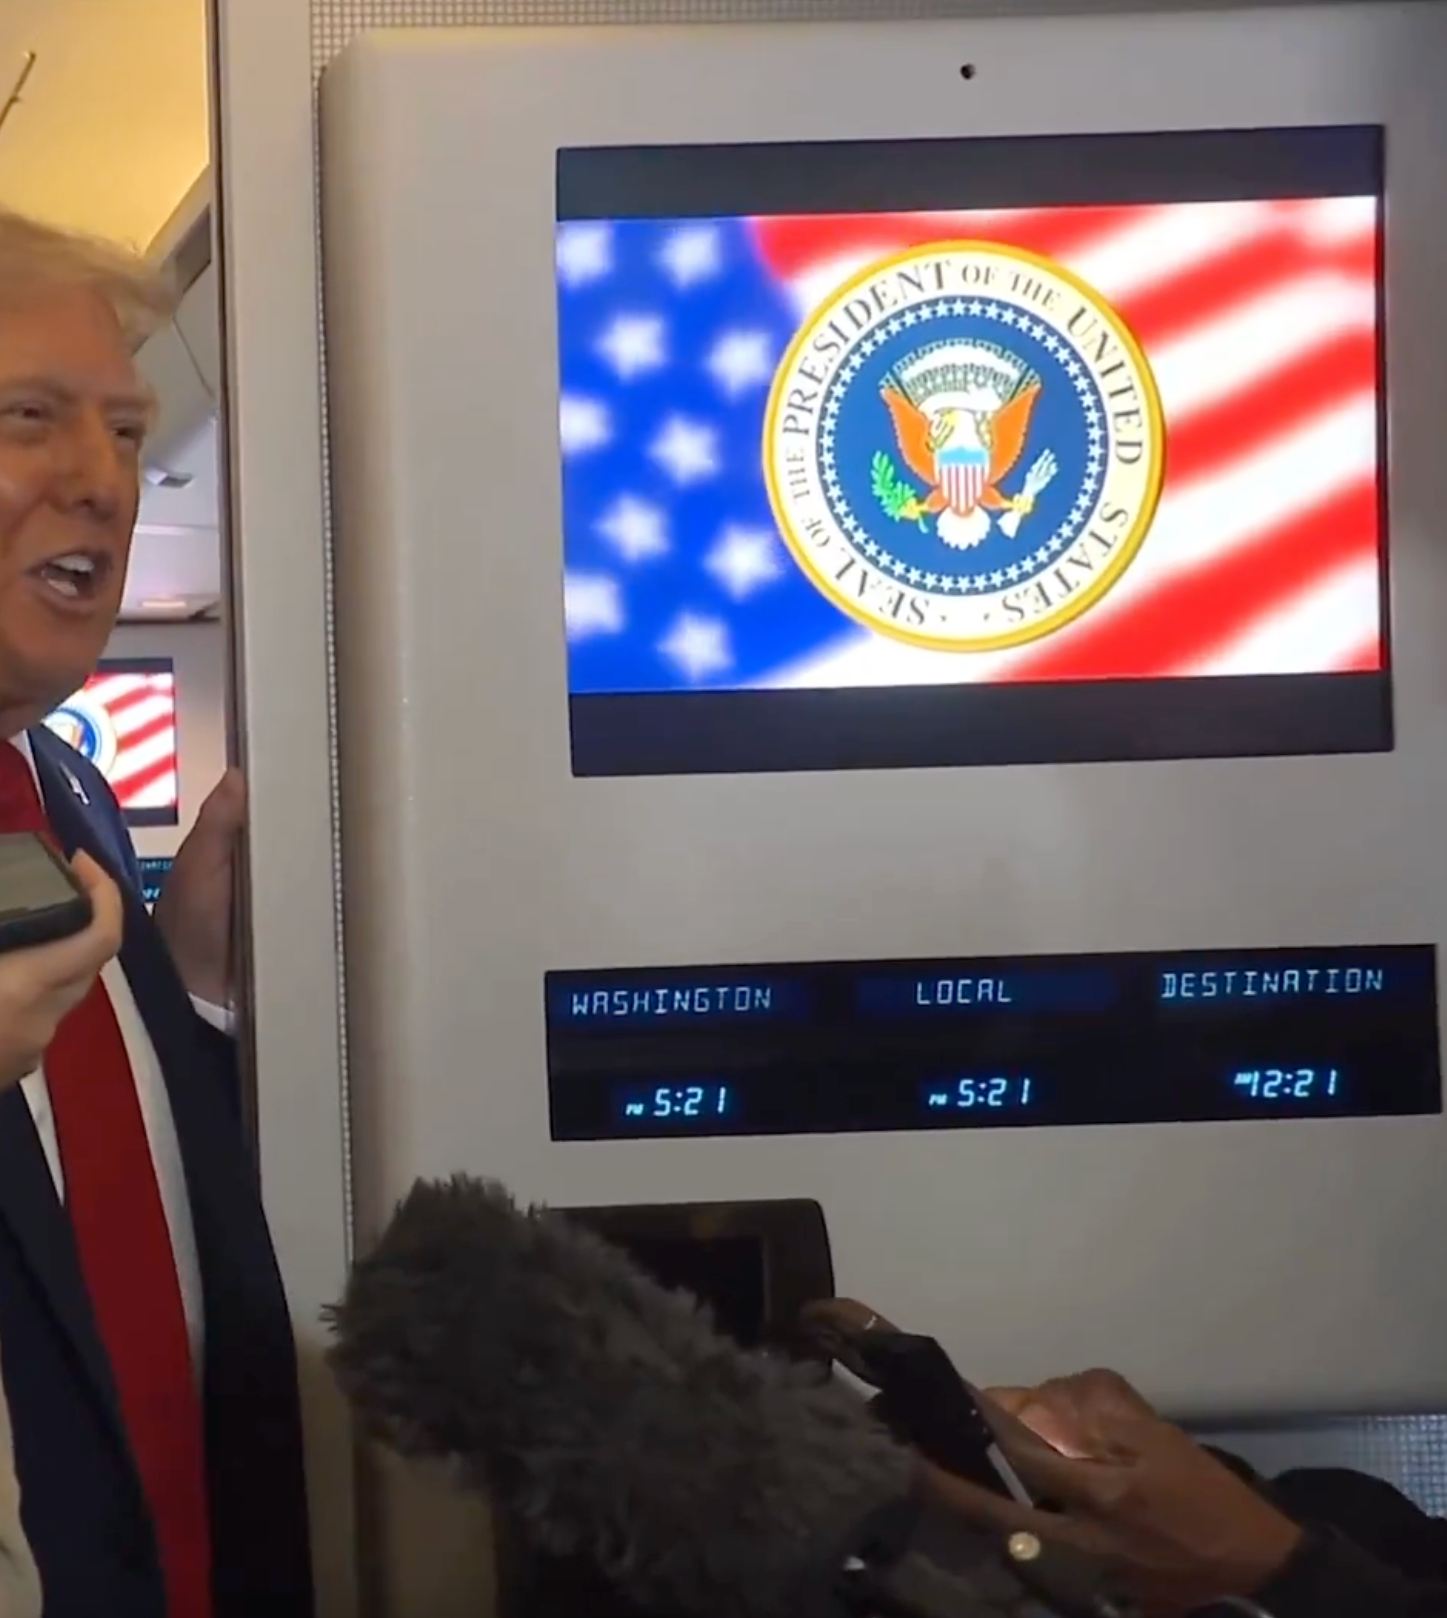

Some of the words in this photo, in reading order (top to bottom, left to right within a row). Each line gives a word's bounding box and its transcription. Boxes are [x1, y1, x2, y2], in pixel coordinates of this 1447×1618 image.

[962, 263, 996, 287] OF
[1008, 271, 1062, 310] THE
[783, 261, 953, 435] PRESIDENT
[1066, 306, 1144, 465] UNITED
[787, 447, 811, 501] THE
[802, 517, 830, 549] OF
[1001, 500, 1129, 623] STATES
[835, 546, 929, 625] SEAL
[916, 979, 1011, 1004] LOCAL
[1161, 968, 1383, 998] DESTINATION
[572, 986, 771, 1015] WASHINGTON
[957, 1078, 1031, 1107] 5:21
[1251, 1069, 1337, 1098] 12:21
[653, 1086, 726, 1117] 5:21
